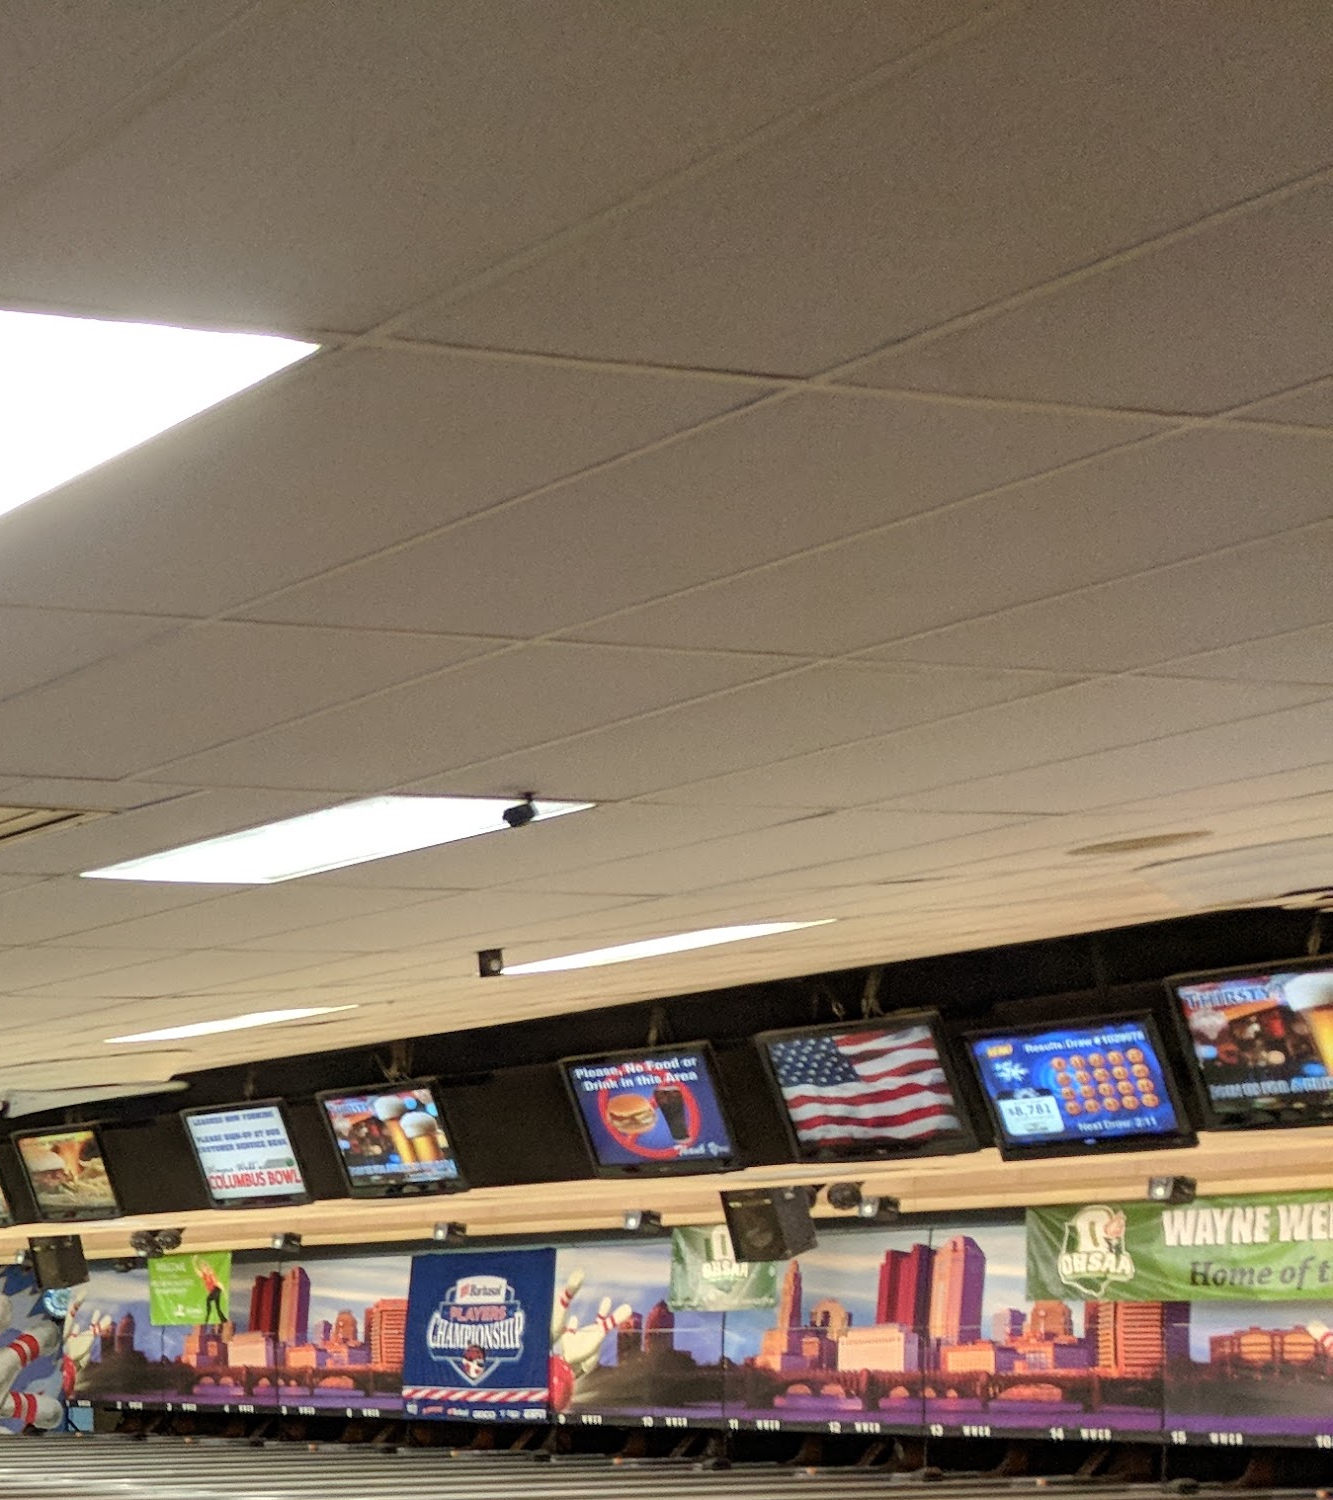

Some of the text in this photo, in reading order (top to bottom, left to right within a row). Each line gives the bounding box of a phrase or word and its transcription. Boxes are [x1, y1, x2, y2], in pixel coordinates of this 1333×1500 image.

[575, 1056, 698, 1079] Please, No Food or
[584, 1070, 698, 1092] Drink in this Area
[209, 1169, 302, 1189] COLUMBUS BOWL
[1161, 1205, 1271, 1247] WAYNE
[1060, 1253, 1134, 1276] OHSAA
[1189, 1260, 1274, 1286] Home
[1279, 1256, 1317, 1290] of
[449, 1305, 508, 1322] PLAYERS
[429, 1311, 523, 1350] CHAMPIONSHIP
